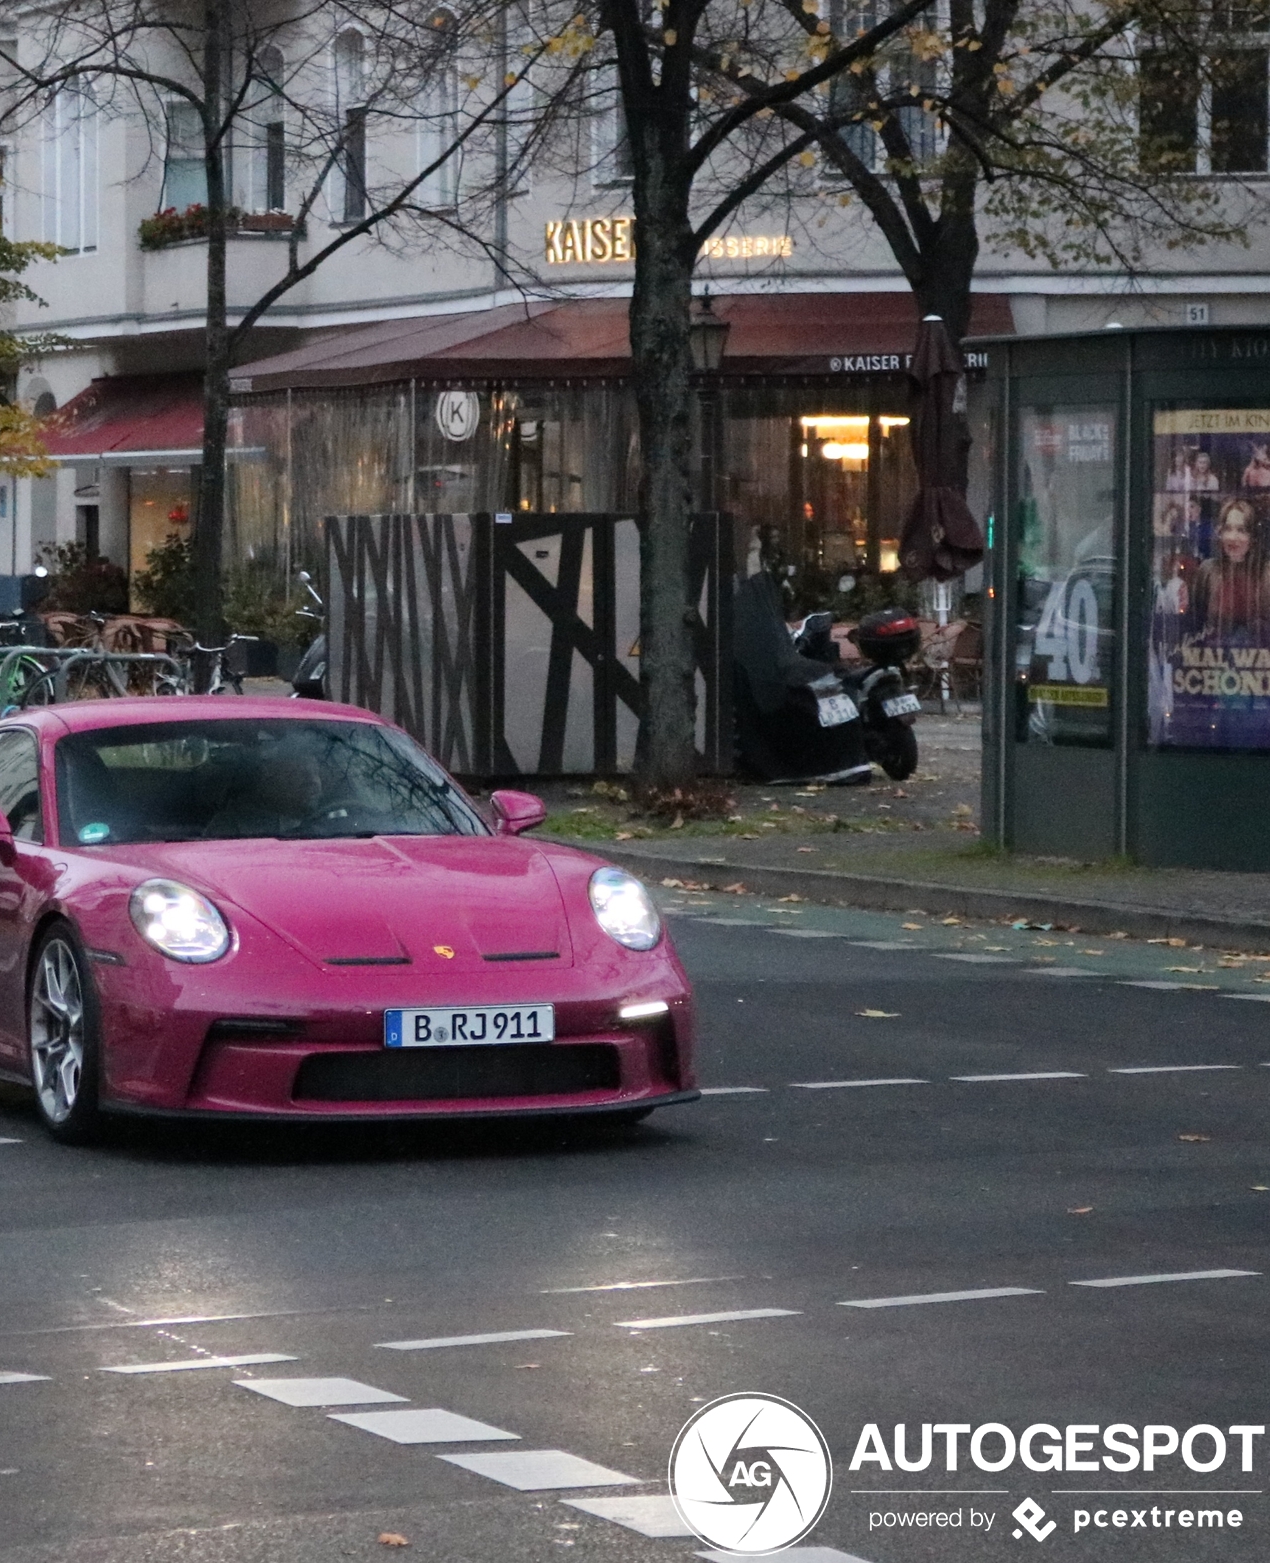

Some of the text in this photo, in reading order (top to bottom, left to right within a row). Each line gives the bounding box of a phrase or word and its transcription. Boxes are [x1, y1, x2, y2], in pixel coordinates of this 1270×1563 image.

[545, 217, 636, 264] KAISE
[1190, 307, 1204, 320] 51
[844, 355, 900, 371] KAISER
[1034, 578, 1098, 684] 40
[415, 1015, 431, 1041] B
